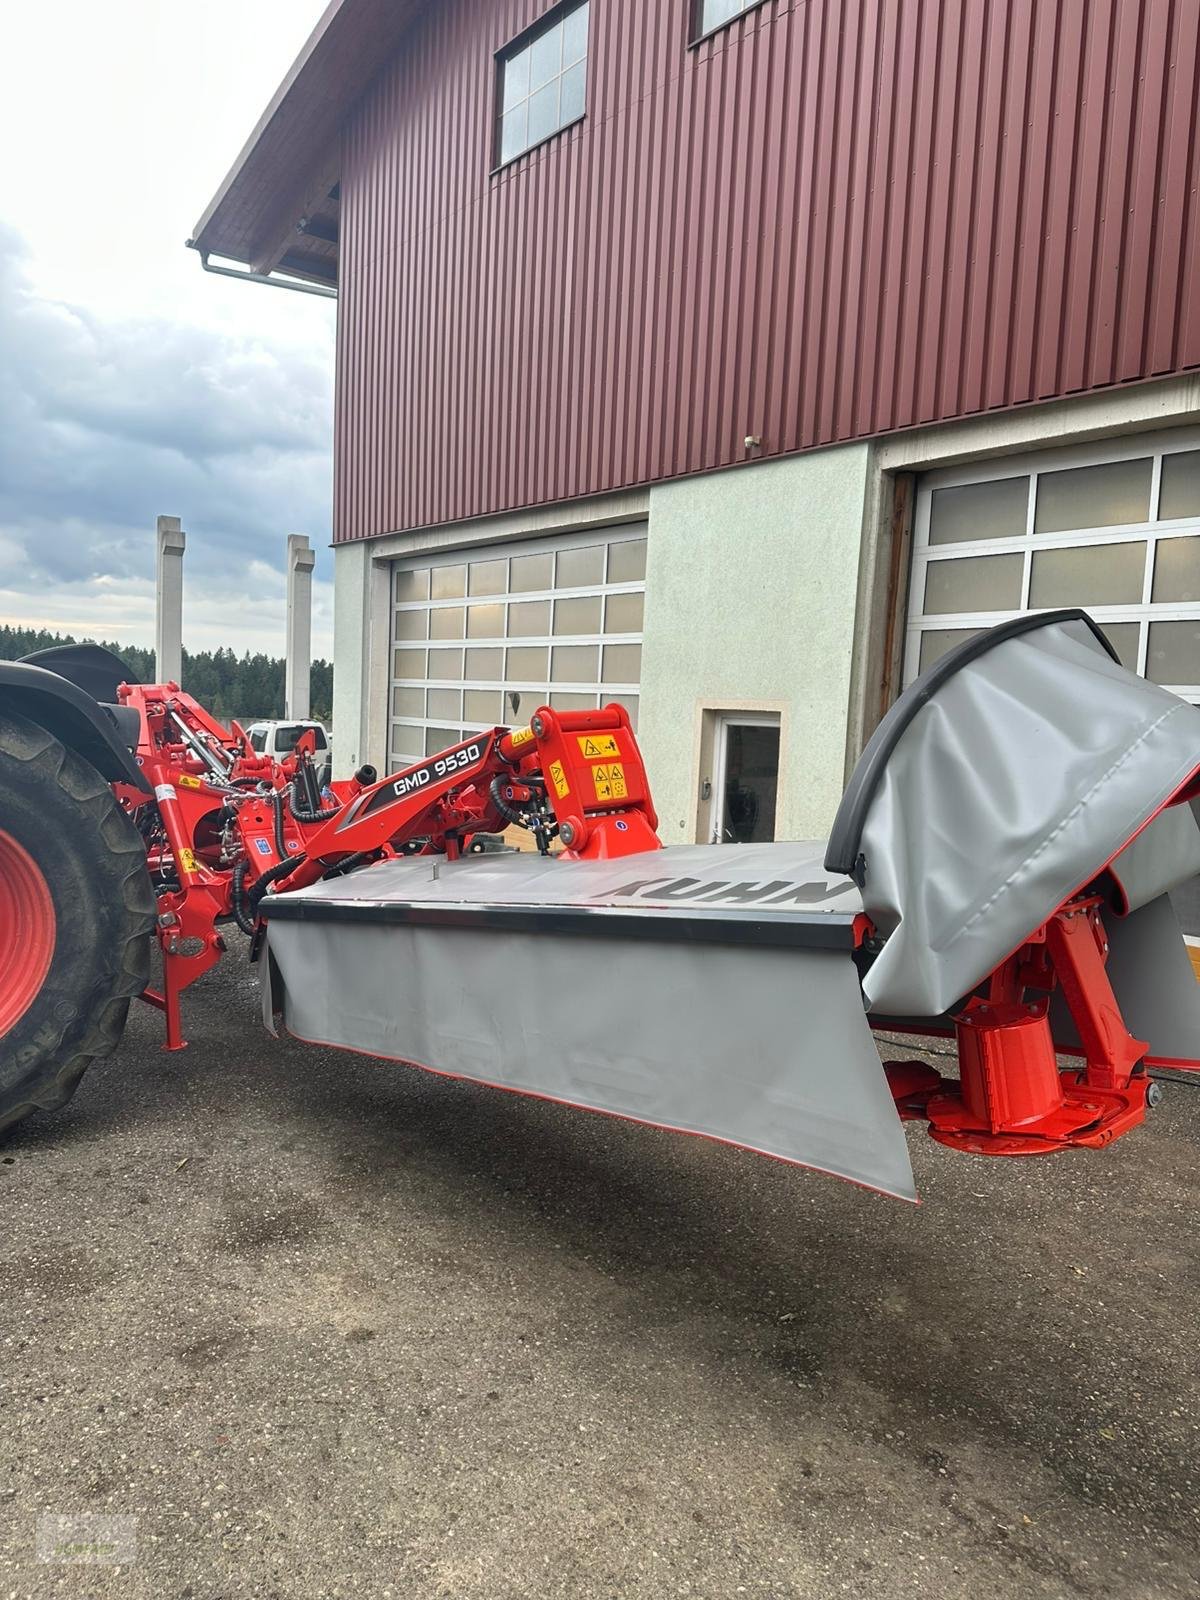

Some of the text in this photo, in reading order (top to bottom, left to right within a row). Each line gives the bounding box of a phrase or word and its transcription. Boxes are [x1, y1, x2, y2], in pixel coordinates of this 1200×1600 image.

[393, 744, 480, 796] GMD 9530
[590, 877, 857, 904] KUHN
